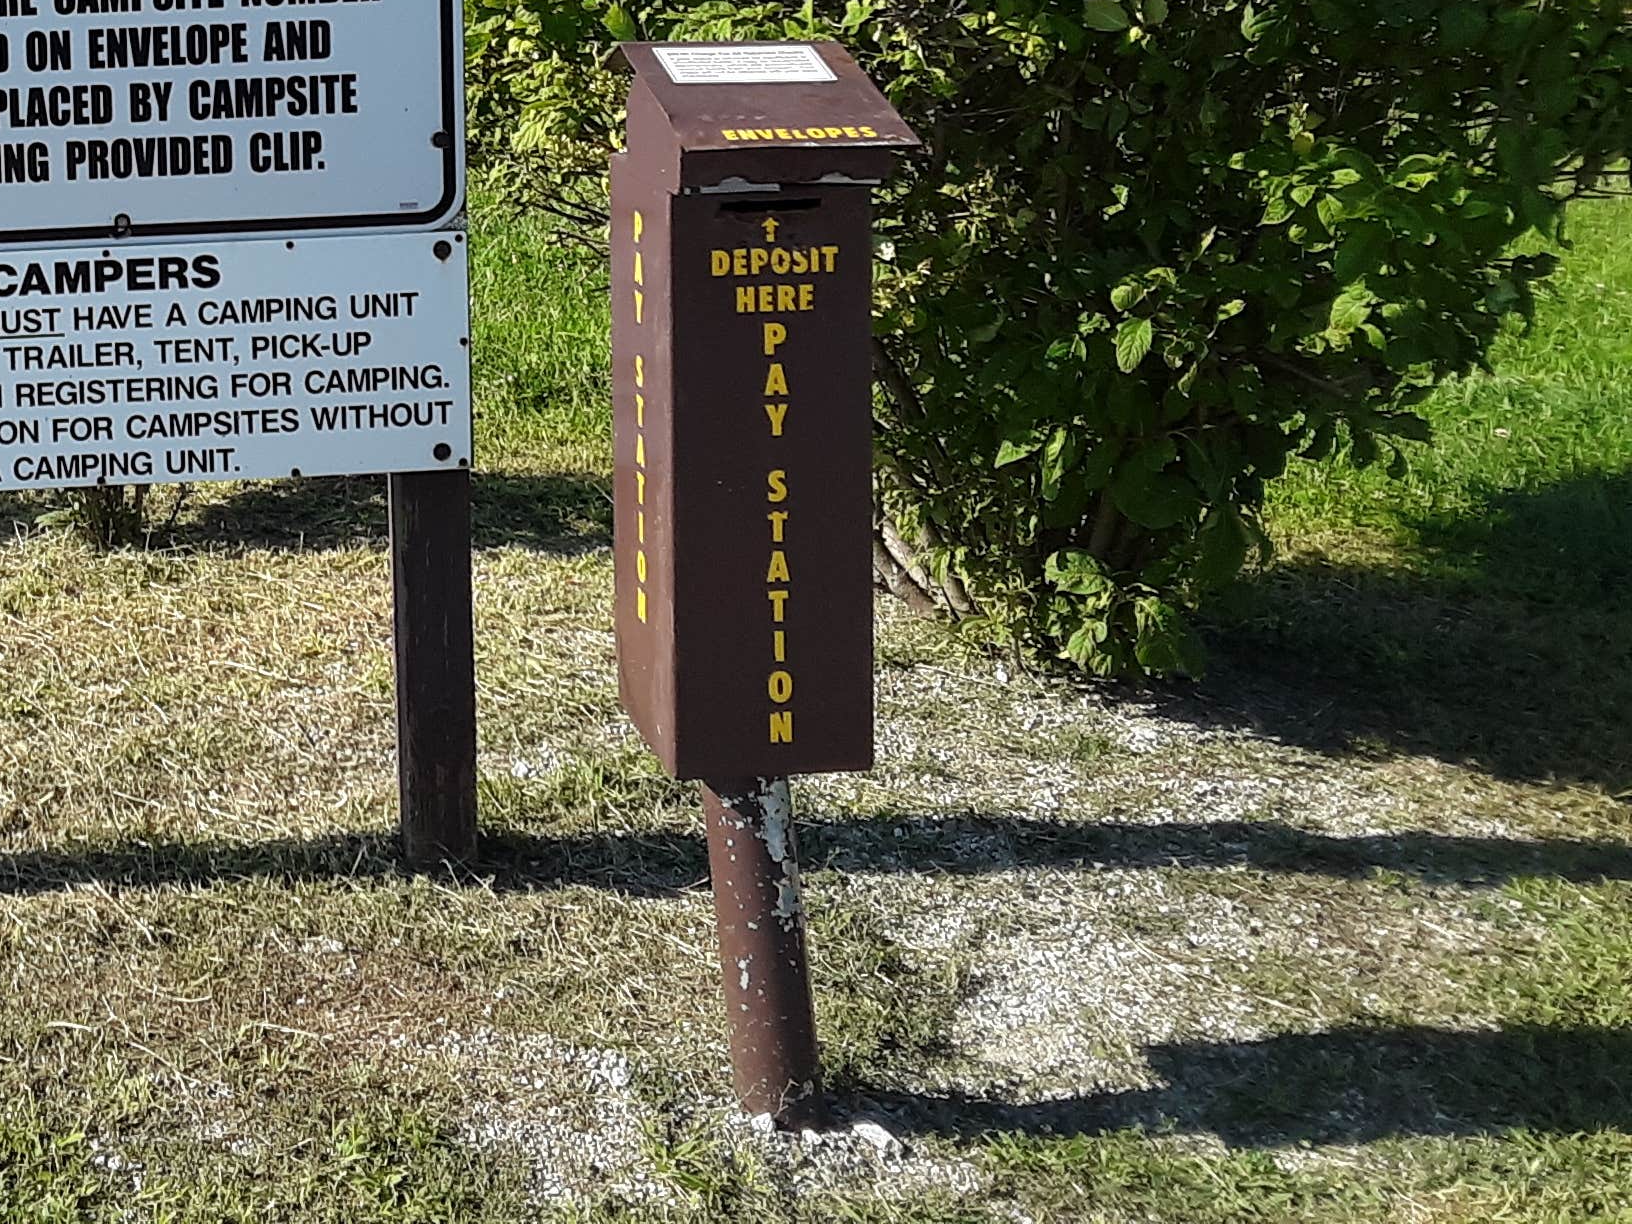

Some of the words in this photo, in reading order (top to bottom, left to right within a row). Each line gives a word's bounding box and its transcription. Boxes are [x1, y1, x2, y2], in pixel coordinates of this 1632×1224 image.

[26, 30, 71, 71] ON
[88, 23, 248, 68] ENVELOPE
[264, 20, 331, 61] AND
[130, 82, 172, 122] BY
[189, 74, 358, 120] CAMPSITE
[722, 127, 877, 141] ENVELOPES
[66, 135, 232, 180] PROVIDED
[250, 131, 325, 173] CLIP.
[711, 246, 839, 277] DEPOSIT
[73, 304, 152, 331] HAVE
[166, 303, 186, 326] A
[198, 296, 337, 326] CAMPING
[350, 292, 419, 319] UNIT
[736, 284, 814, 313] HERE
[3, 342, 143, 371] TRAILER,
[154, 337, 240, 366] TENT,
[252, 331, 371, 360] PICK-UP
[17, 375, 218, 408] REGISTERING
[231, 373, 292, 398] FOR
[304, 365, 450, 395] CAMPING.
[53, 416, 113, 443] FOR
[126, 408, 299, 440] CAMPSITES
[310, 401, 453, 431] WITHOUT
[13, 452, 153, 482] CAMPING
[166, 448, 241, 474] UNIT.
